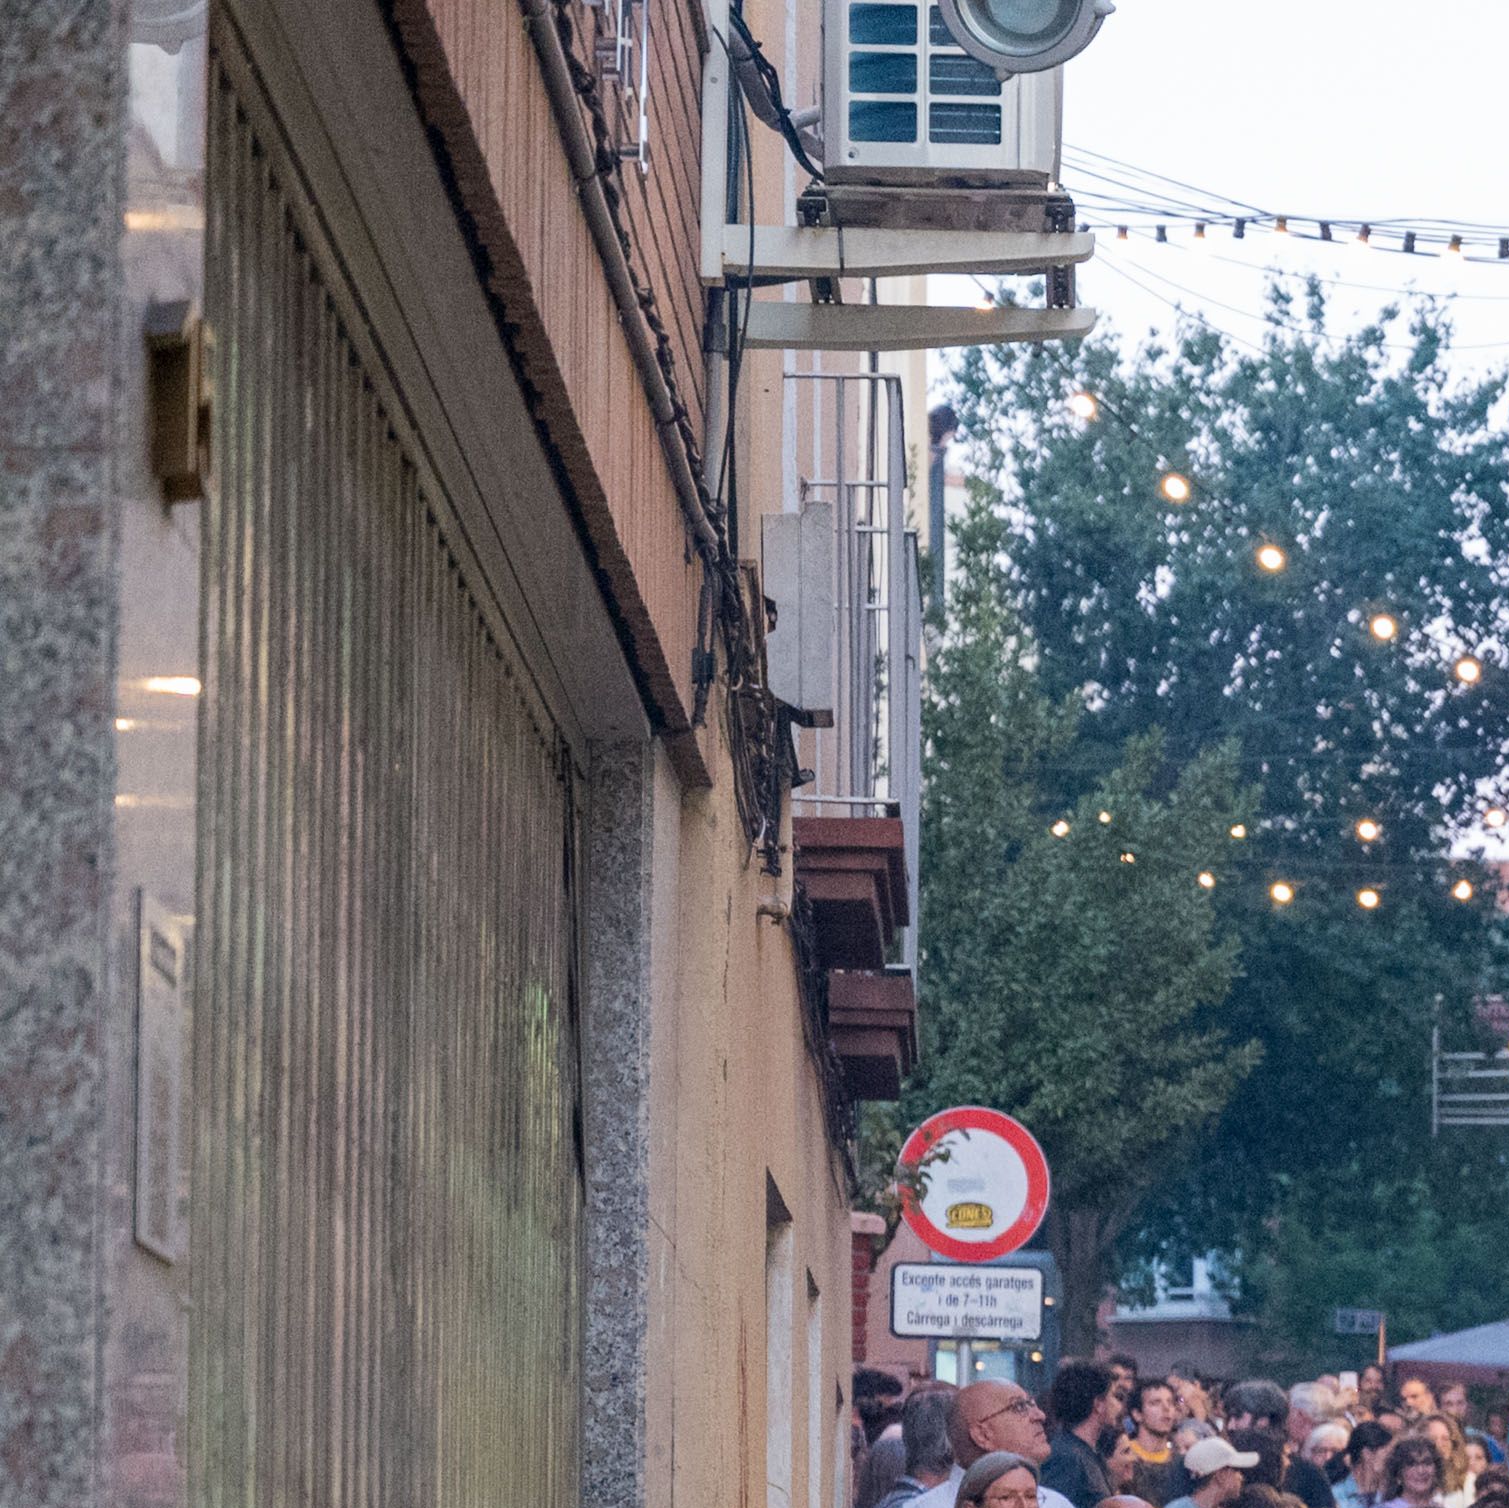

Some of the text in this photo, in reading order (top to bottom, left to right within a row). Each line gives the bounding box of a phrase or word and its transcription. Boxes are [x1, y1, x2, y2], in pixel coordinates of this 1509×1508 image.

[902, 1271, 1034, 1292] Excepte accés garatges
[946, 1293, 959, 1306] de
[906, 1310, 950, 1328] Càrrega
[961, 1314, 1024, 1329] descàrrega
